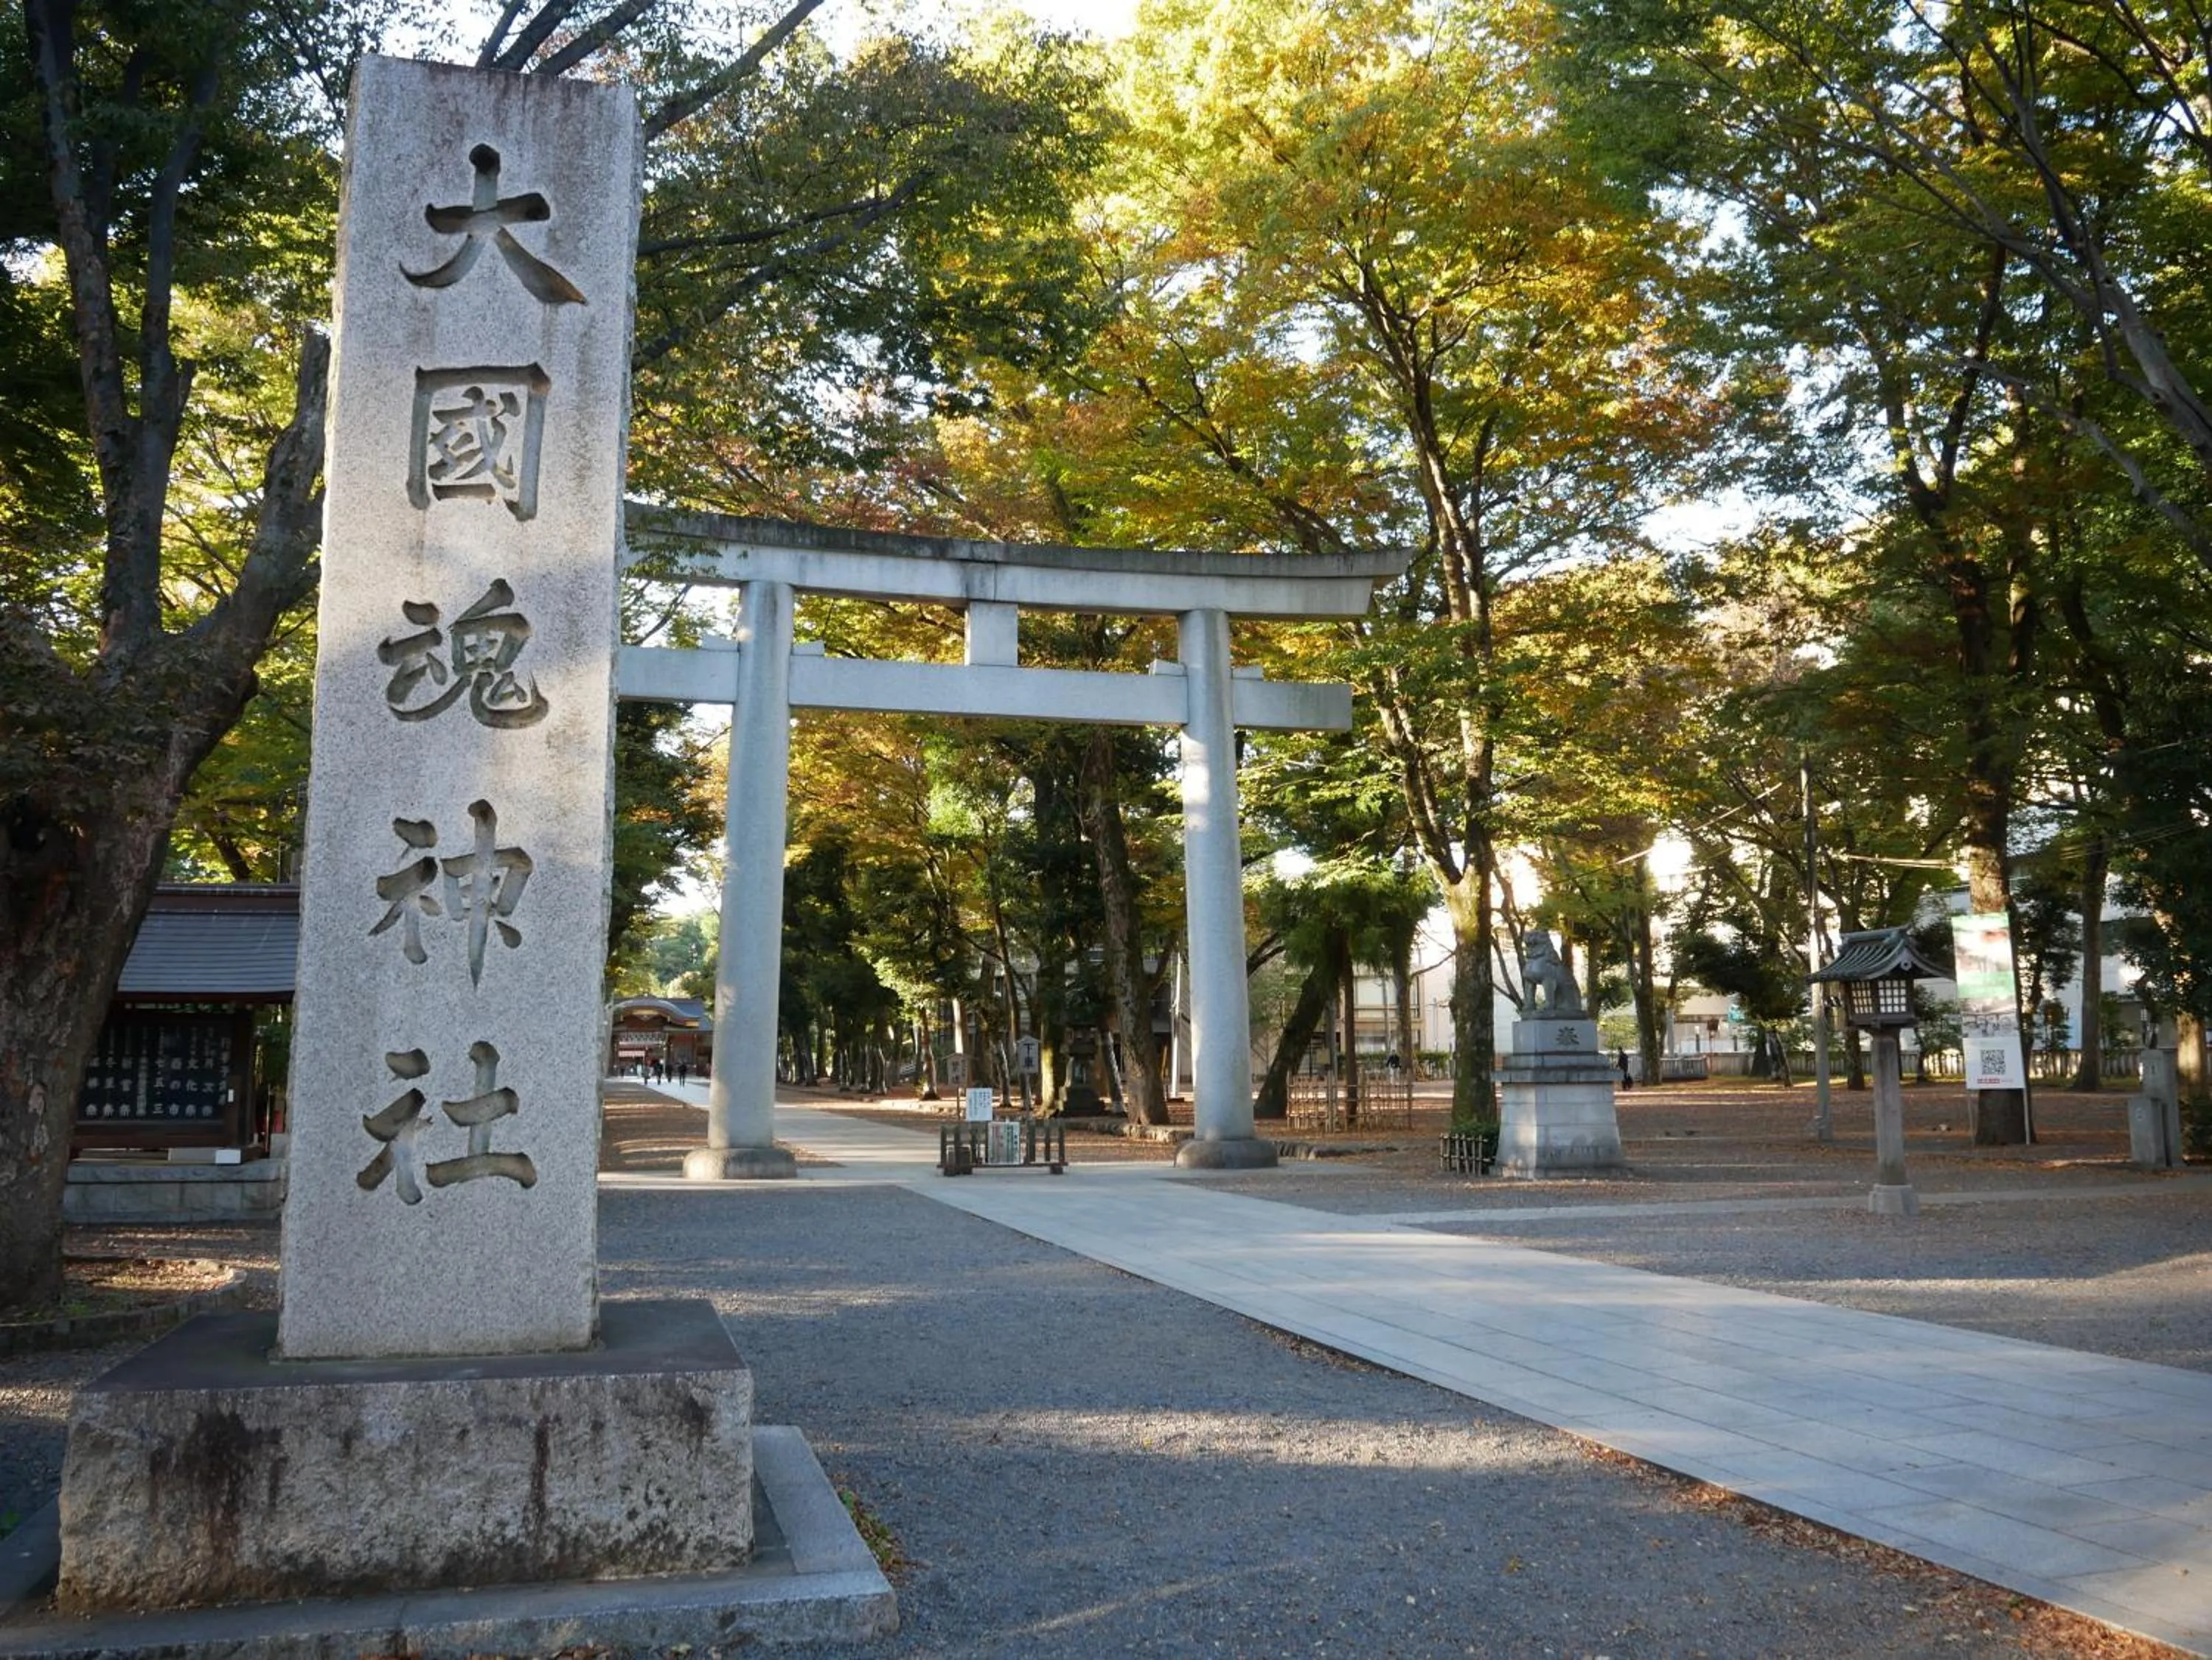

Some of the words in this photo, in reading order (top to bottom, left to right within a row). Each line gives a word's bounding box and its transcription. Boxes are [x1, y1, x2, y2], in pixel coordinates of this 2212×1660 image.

[356, 143, 588, 1206] 大國魂神社
